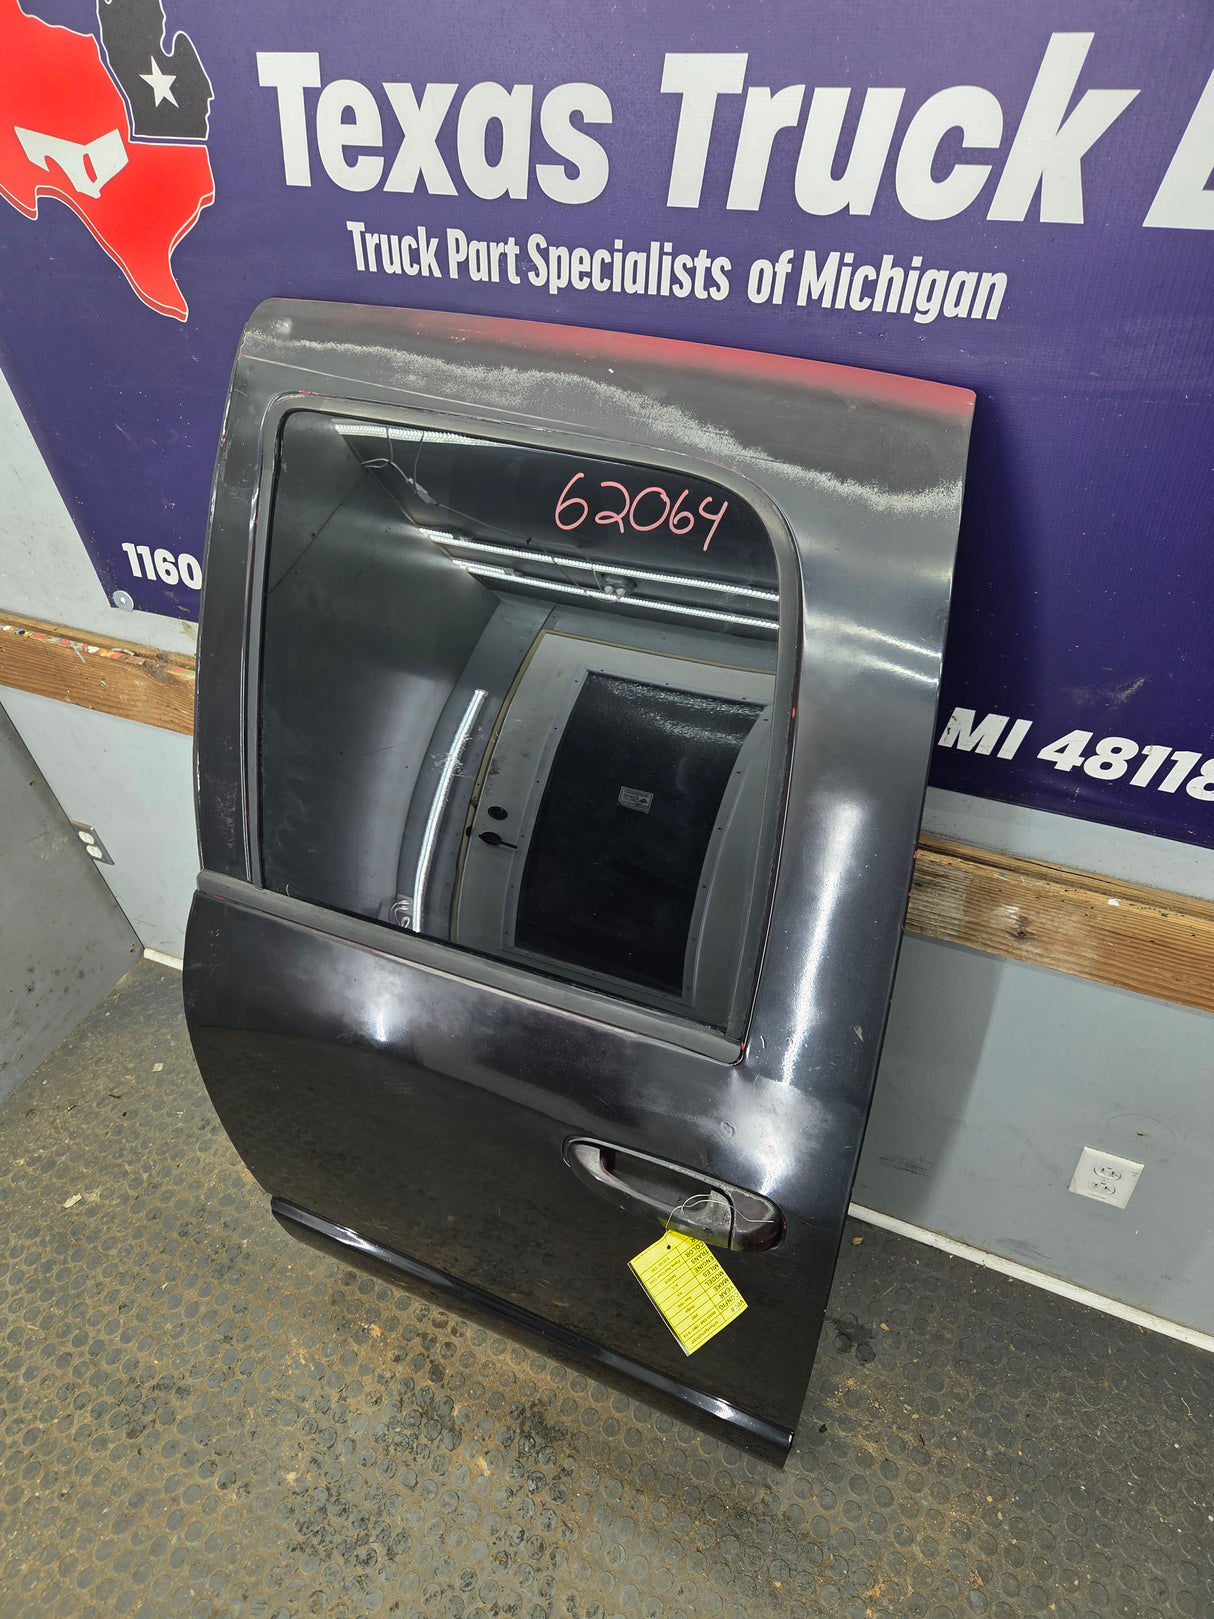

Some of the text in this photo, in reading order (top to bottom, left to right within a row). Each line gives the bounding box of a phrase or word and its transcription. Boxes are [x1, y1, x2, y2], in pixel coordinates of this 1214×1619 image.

[256, 51, 613, 204] Texas
[661, 32, 1141, 224] Truck
[346, 221, 1008, 324] Truck Part Specialists of Michigan
[555, 472, 729, 552] 62064
[121, 542, 203, 590] 1160
[937, 707, 1214, 802] MI 48118
[684, 1241, 704, 1257] COLOR
[689, 1248, 709, 1264] TRANS
[693, 1255, 714, 1273] ENGINE
[701, 1262, 719, 1277] MILES
[704, 1269, 724, 1287] MODEL
[712, 1276, 729, 1292] MAKE
[718, 1284, 734, 1299] YEAR
[718, 1291, 739, 1310] CONFIG
